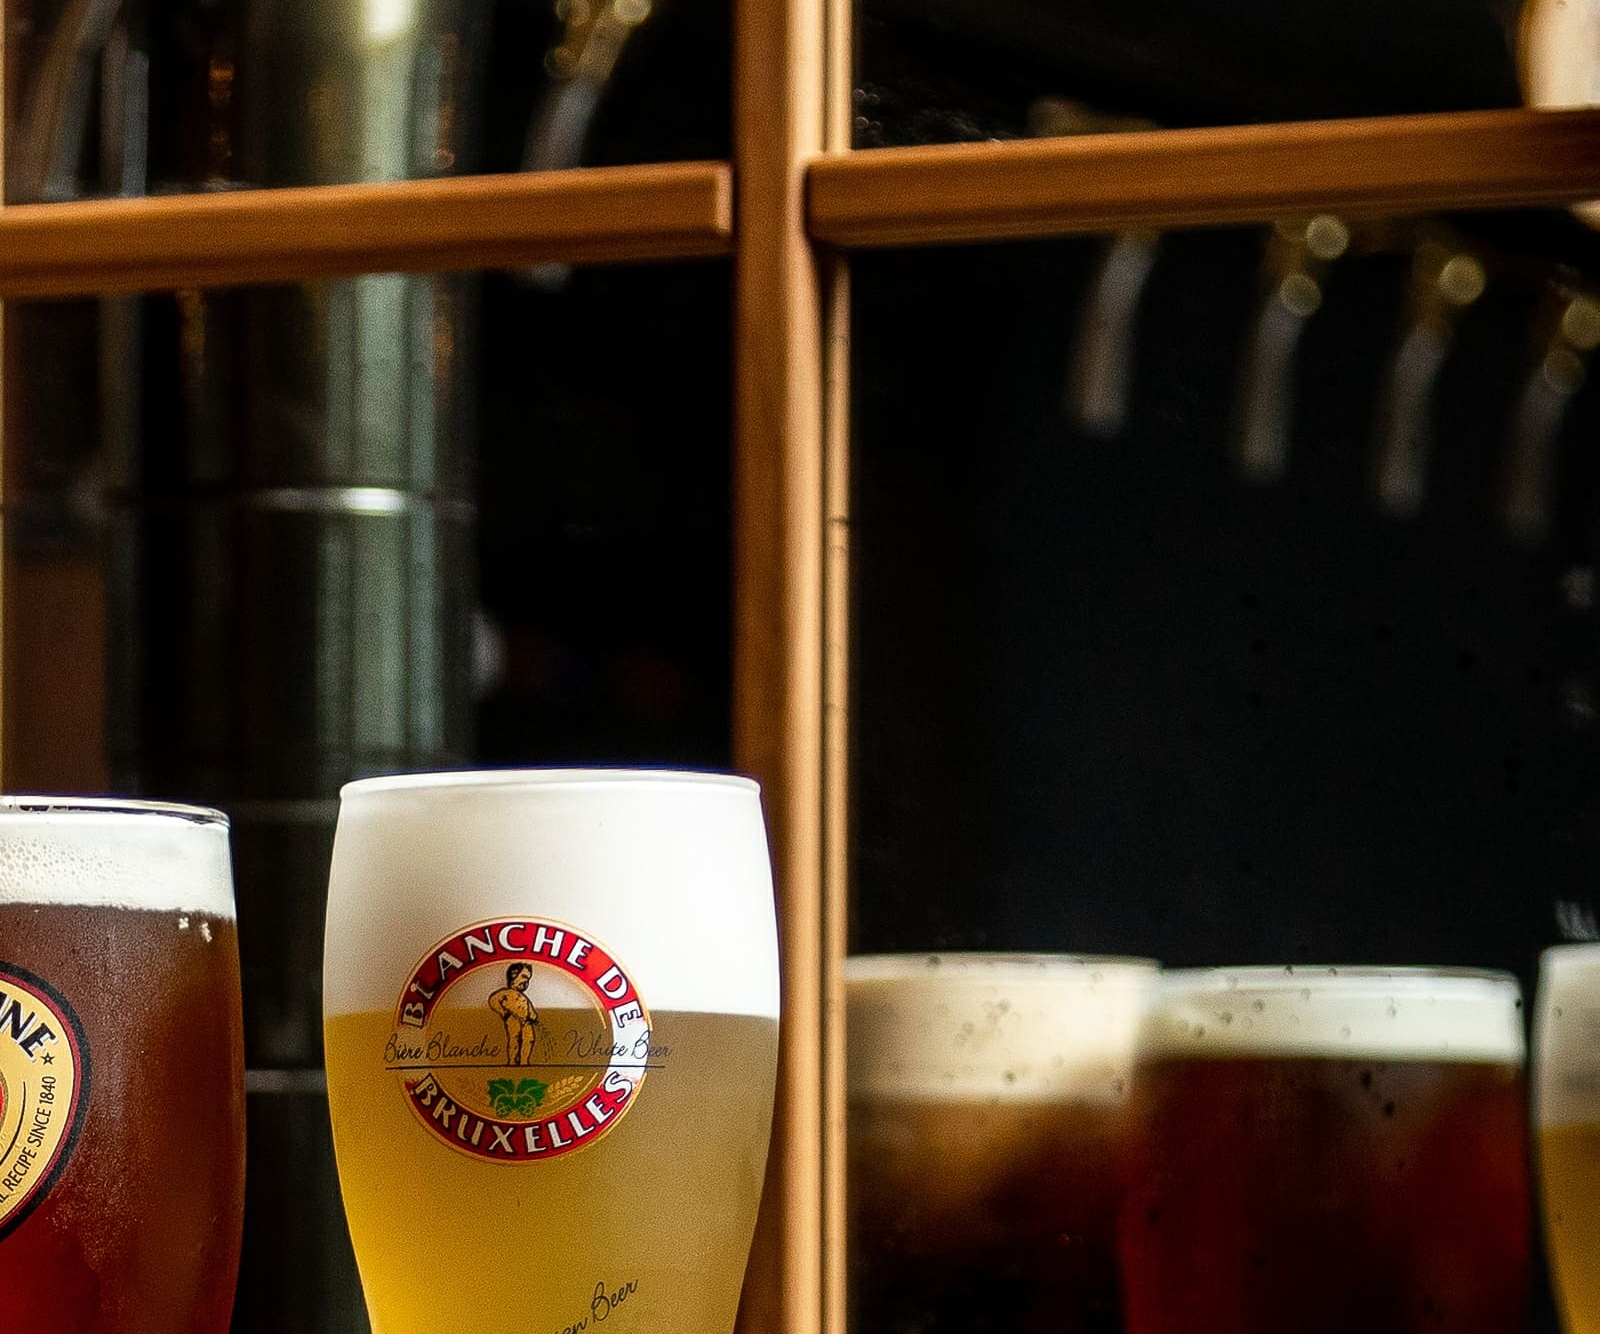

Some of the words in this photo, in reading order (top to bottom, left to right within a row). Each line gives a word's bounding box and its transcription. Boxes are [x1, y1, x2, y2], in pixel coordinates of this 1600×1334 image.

[401, 923, 592, 1029] BLANCHE
[595, 964, 643, 1029] DE
[383, 1032, 423, 1062] Bière
[424, 1033, 501, 1060] Blanche
[39, 1075, 57, 1105] 1840
[27, 1107, 52, 1148] SINCE
[411, 1071, 634, 1155] BRUXELLES
[1, 1146, 37, 1192] RECIPE
[590, 1279, 639, 1323] Beer
